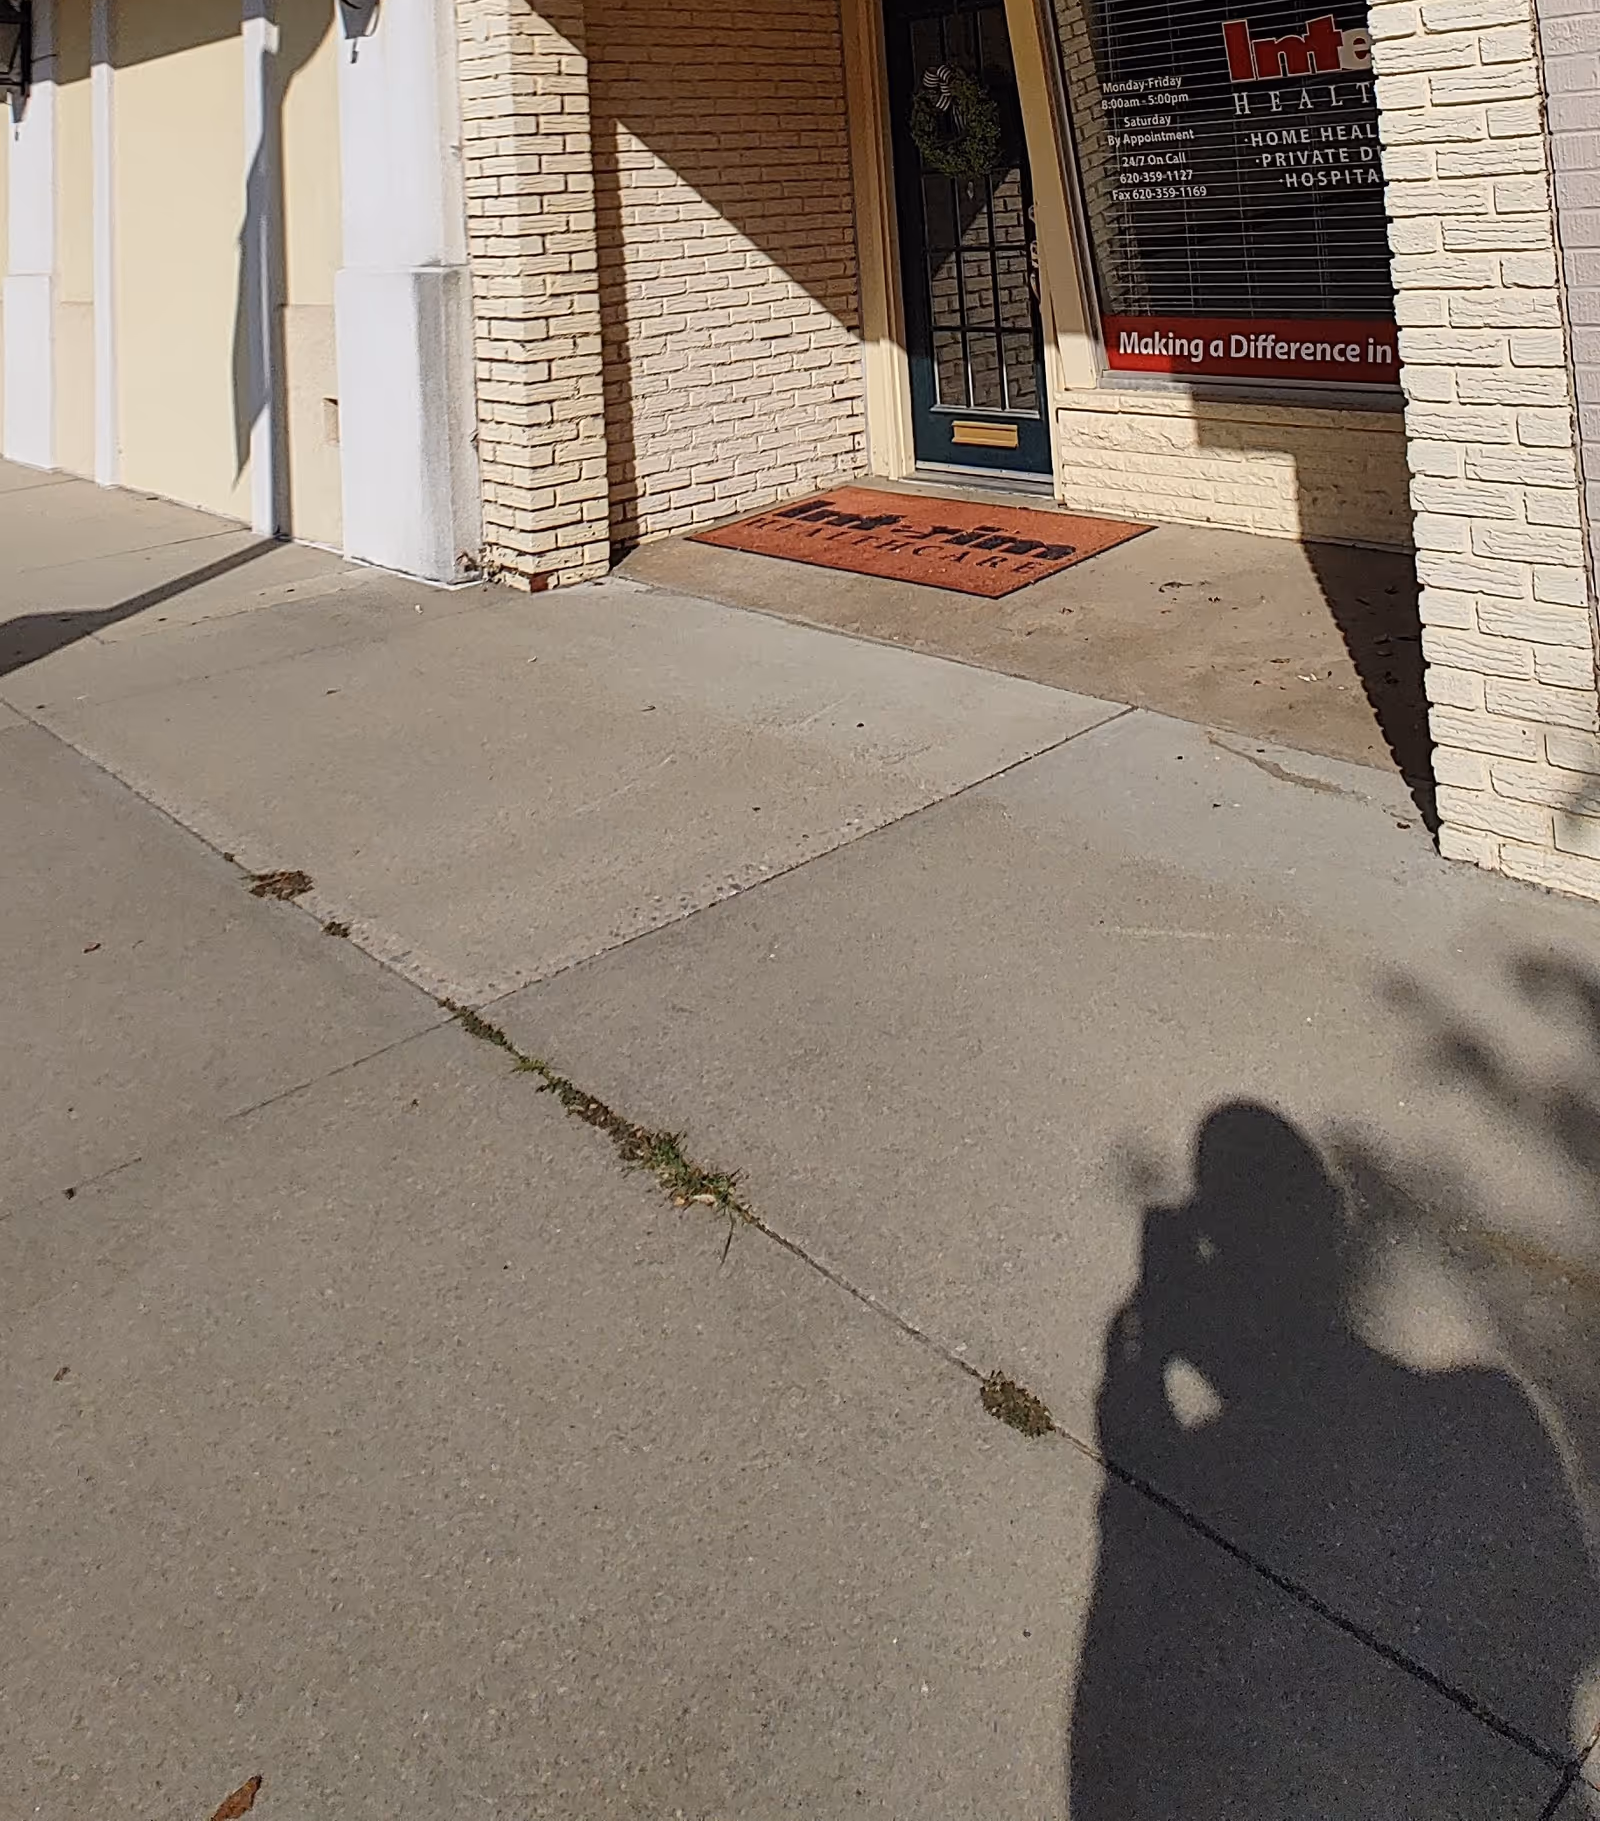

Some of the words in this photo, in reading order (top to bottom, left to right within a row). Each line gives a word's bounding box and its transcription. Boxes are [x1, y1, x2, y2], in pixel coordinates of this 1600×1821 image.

[1102, 76, 1182, 93] Monday-Friday
[1101, 98, 1140, 110] 8:00am
[1148, 93, 1189, 106] 5:00pm
[1124, 114, 1171, 127] Saturday
[1107, 135, 1121, 147] By
[1123, 129, 1195, 147] Appointment
[1321, 123, 1377, 141] HEAL
[1122, 155, 1145, 167] 24/7
[1147, 155, 1164, 165] On
[1166, 152, 1186, 164] Call
[1120, 169, 1192, 184] 620-359-1127
[1112, 189, 1131, 201] Fax
[1132, 186, 1207, 200] 620-359-1169
[1119, 331, 1203, 363] Making
[1209, 340, 1224, 357] a
[1230, 334, 1361, 362] Difference
[1367, 338, 1392, 363] in
